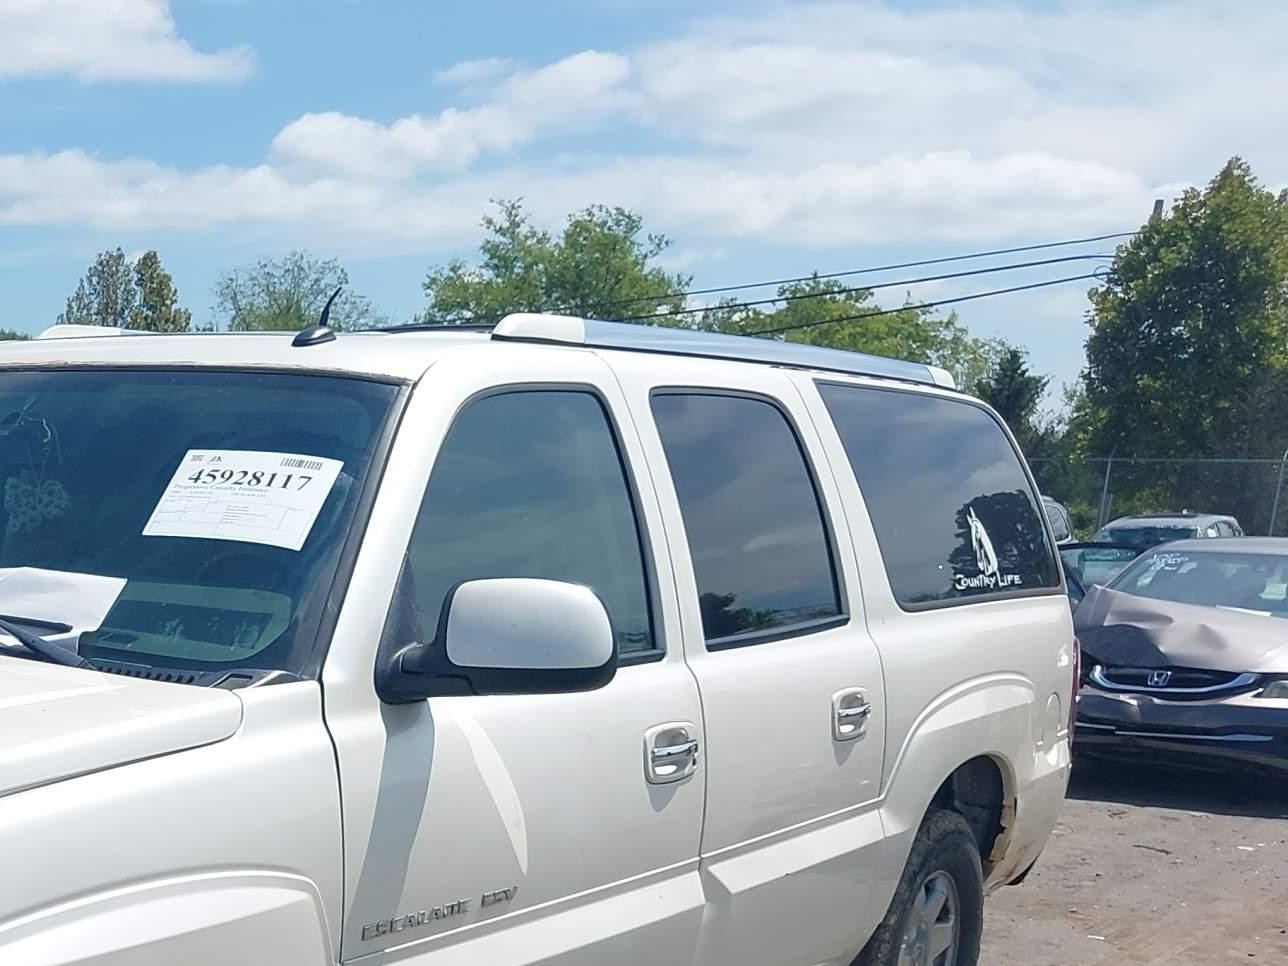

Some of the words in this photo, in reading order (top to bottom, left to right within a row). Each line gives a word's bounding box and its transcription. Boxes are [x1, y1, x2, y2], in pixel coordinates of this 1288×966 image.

[188, 468, 313, 491] 45928117
[361, 898, 472, 941] ESCALADE
[481, 885, 519, 908] ESV
